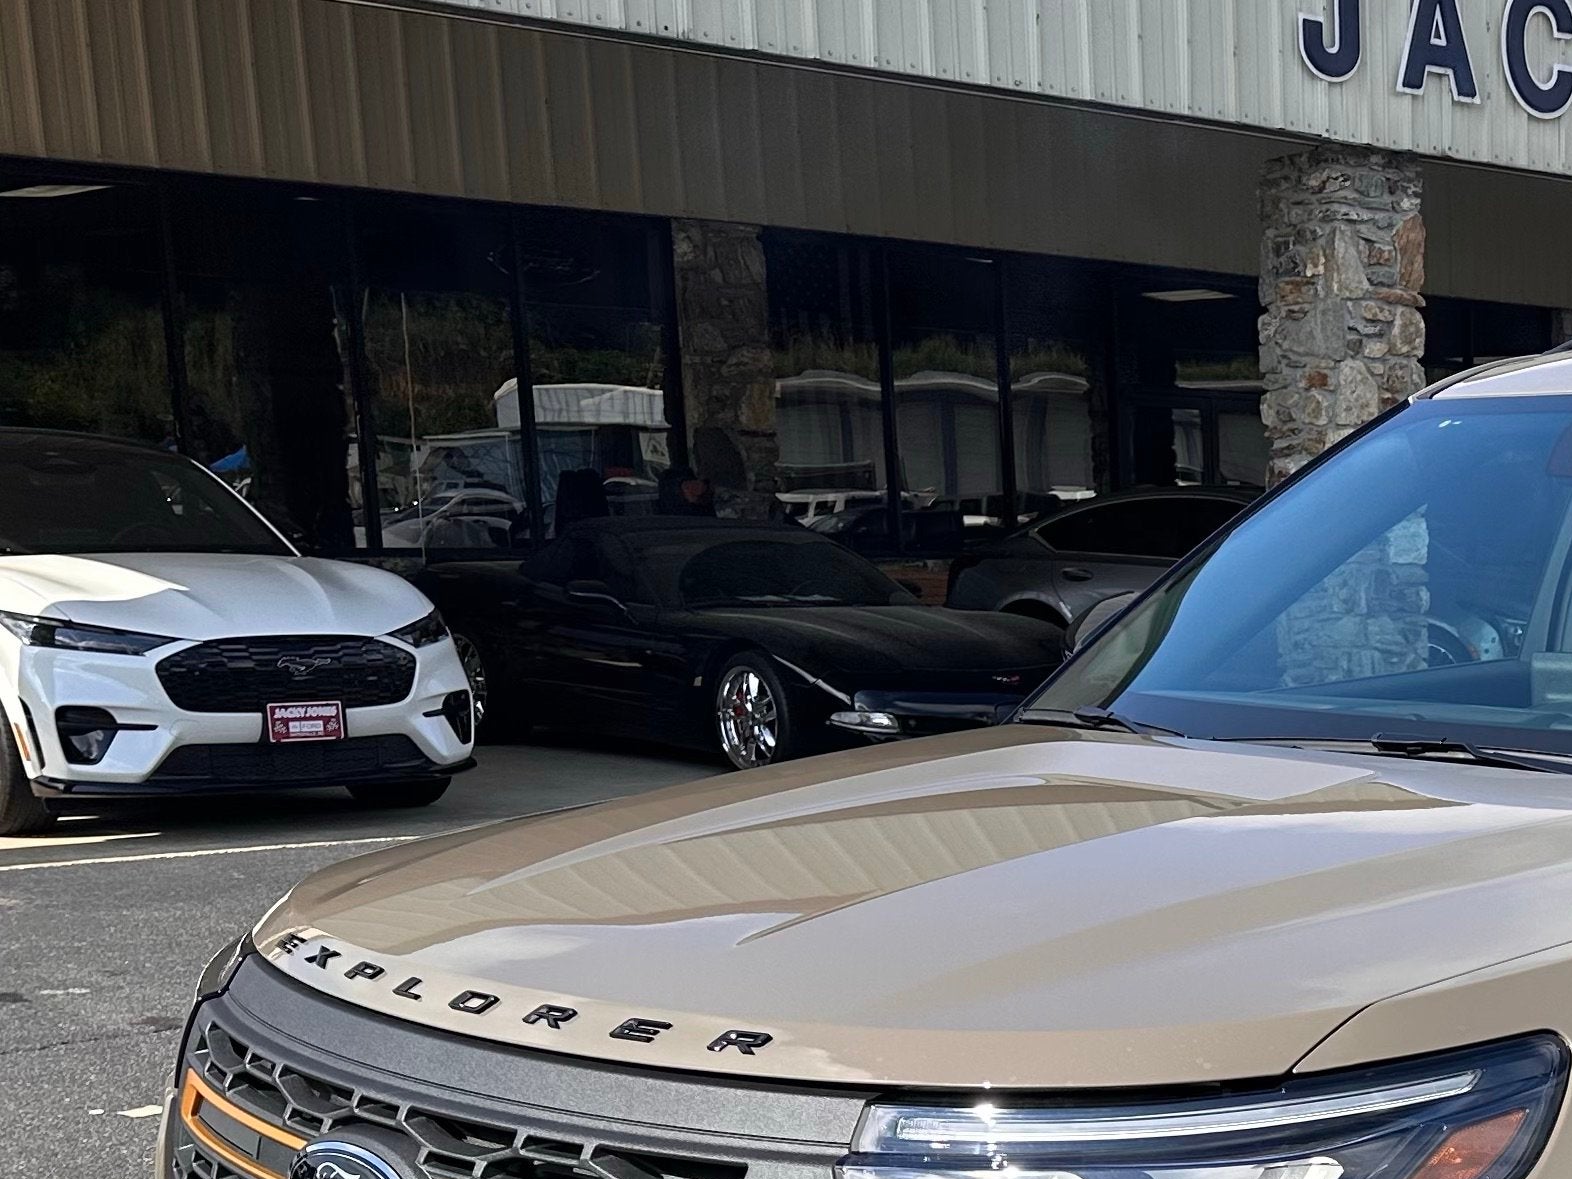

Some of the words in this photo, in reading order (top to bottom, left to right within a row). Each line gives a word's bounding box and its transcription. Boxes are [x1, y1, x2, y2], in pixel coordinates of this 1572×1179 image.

[273, 707, 306, 719] JACKY
[305, 706, 338, 718] JONES
[274, 931, 774, 1056] EXPLORER
